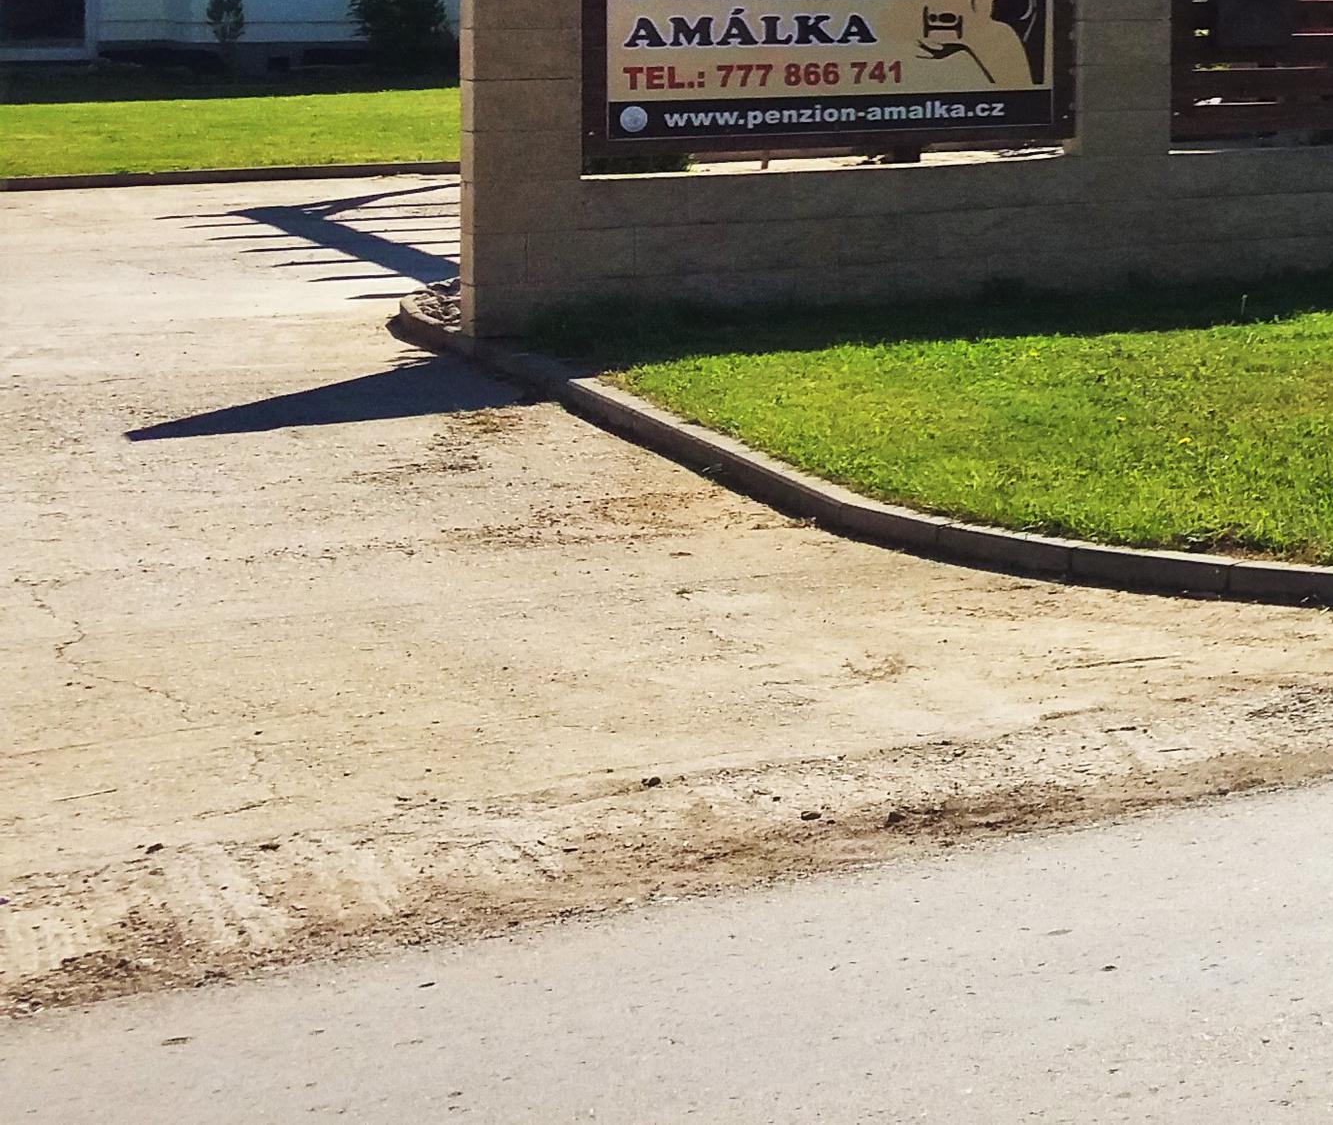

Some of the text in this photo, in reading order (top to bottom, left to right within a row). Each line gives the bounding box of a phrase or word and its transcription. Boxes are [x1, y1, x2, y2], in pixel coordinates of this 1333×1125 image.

[622, 7, 878, 49] AMÁLKA
[622, 60, 904, 91] TEL.: 777 866 741
[664, 100, 1006, 129] www.penzion-amalka.cz
